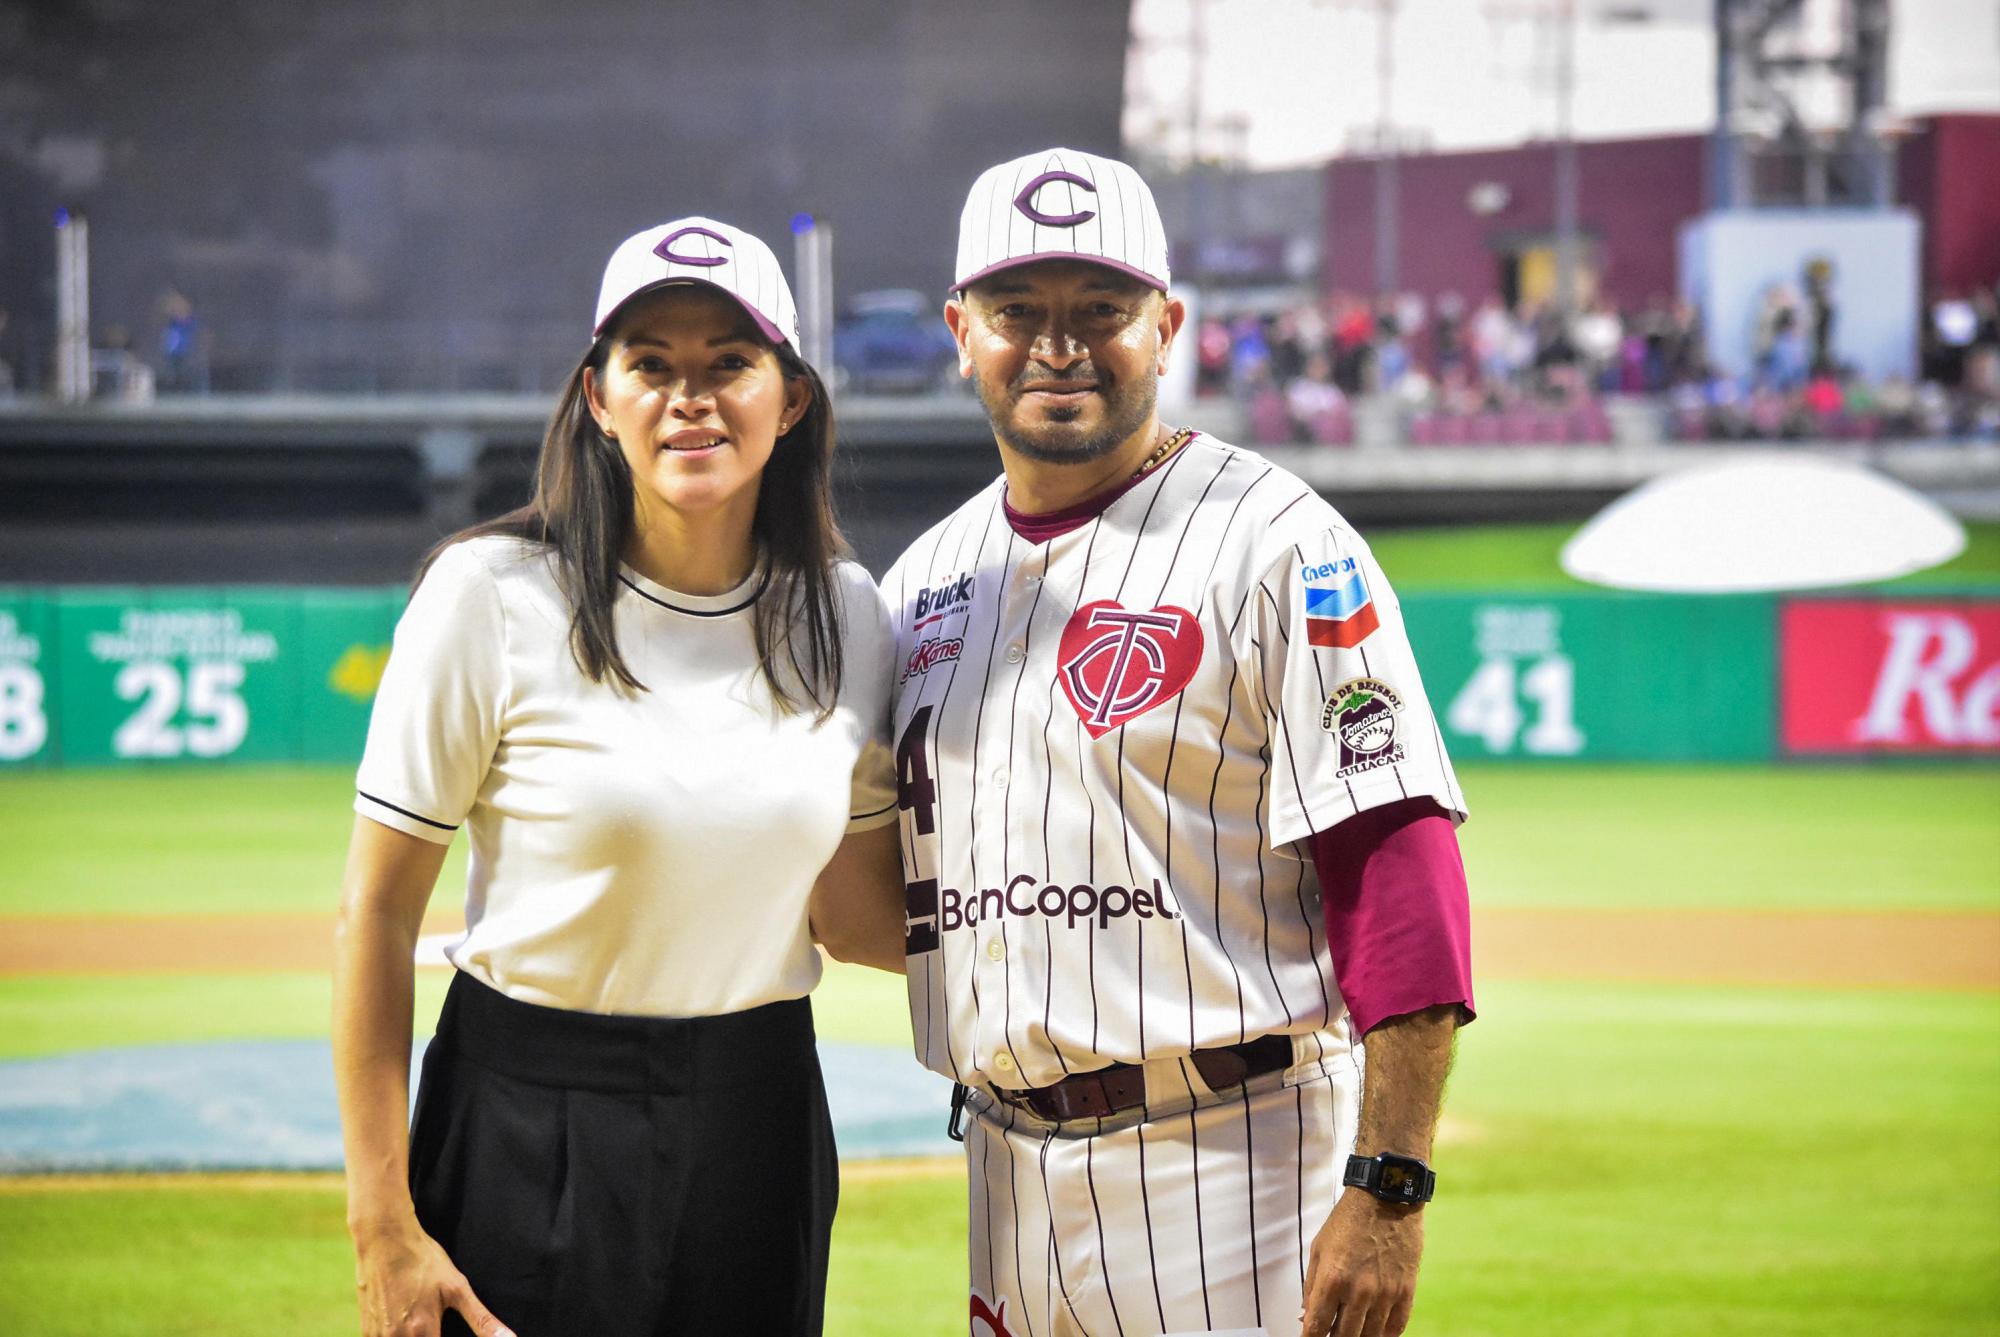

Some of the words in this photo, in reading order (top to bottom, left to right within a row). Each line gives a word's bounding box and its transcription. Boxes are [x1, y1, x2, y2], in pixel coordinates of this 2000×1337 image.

[1013, 170, 1096, 228] C
[652, 227, 733, 267] C
[915, 572, 973, 620] Brück
[112, 660, 250, 759] 25
[1323, 698, 1339, 729] CLUB
[1337, 685, 1354, 699] DE
[1357, 681, 1402, 710] BEISBOL
[1339, 707, 1393, 740] Tomateros
[1449, 657, 1584, 754] 41
[896, 704, 936, 836] 4
[1335, 751, 1405, 779] CULIACAN
[942, 874, 1173, 931] BanCoppel
